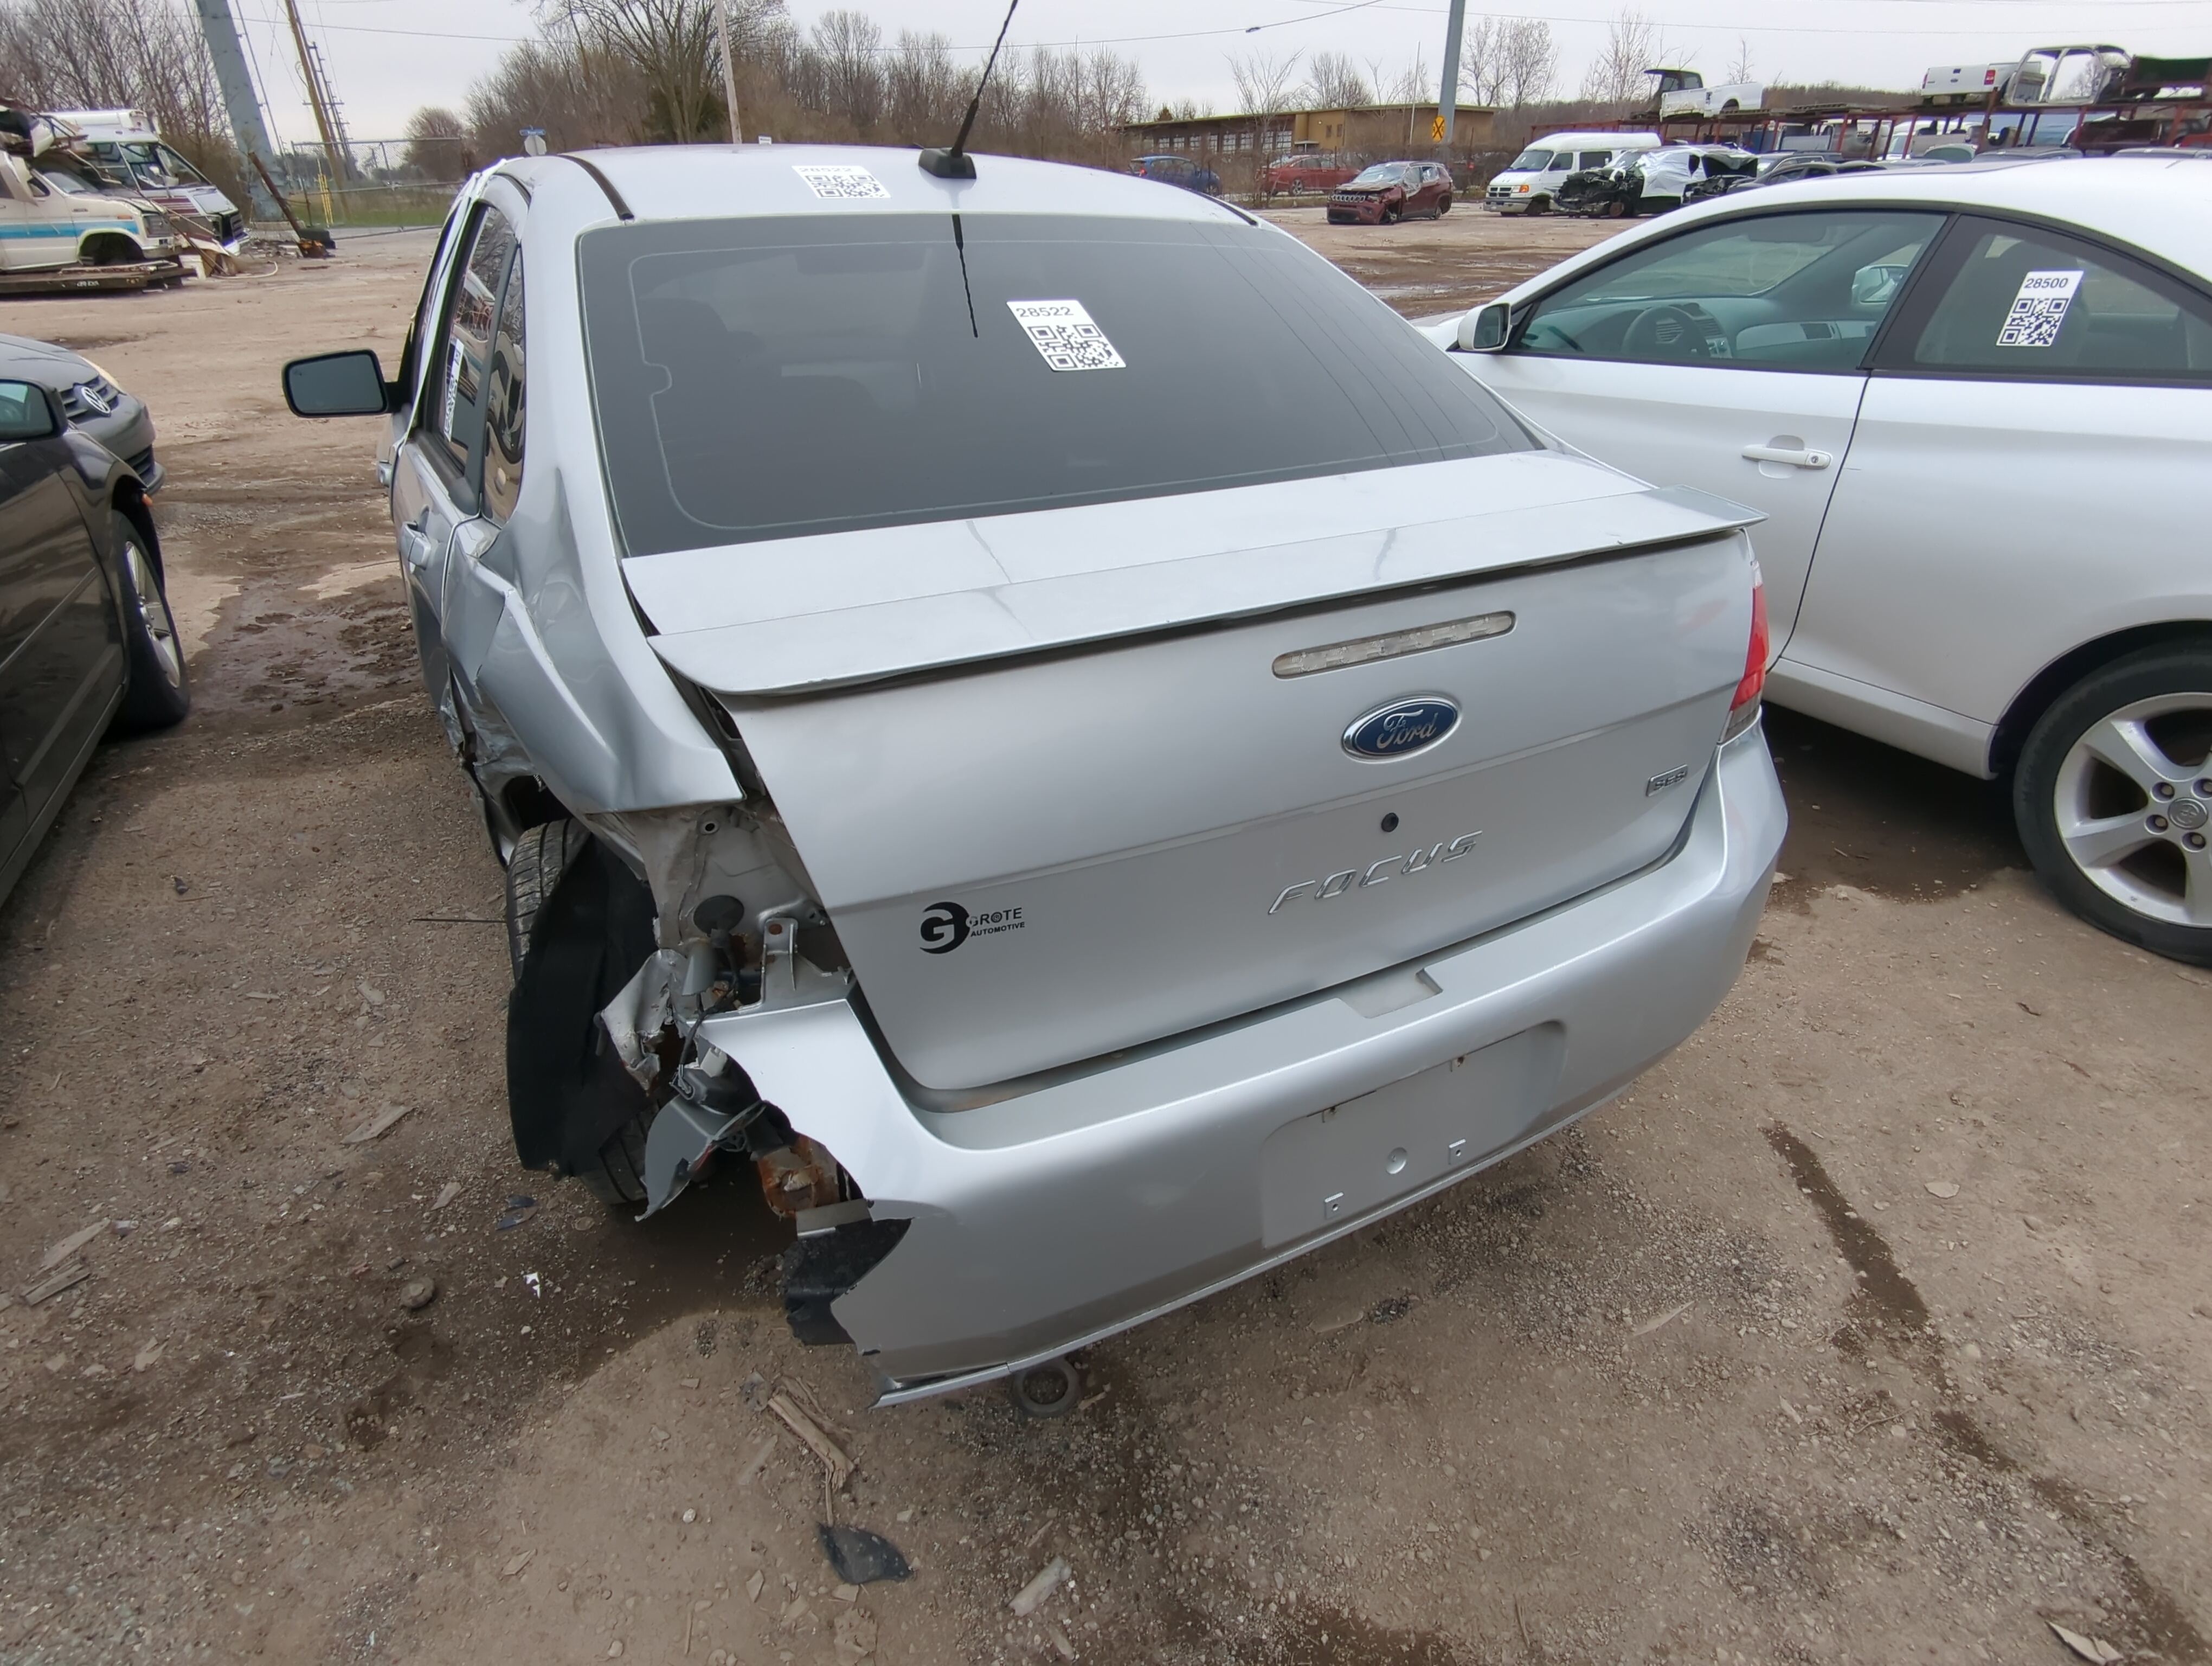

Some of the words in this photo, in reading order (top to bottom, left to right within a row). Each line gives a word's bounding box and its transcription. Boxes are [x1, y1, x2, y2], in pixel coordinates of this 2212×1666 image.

[2023, 278, 2069, 289] 28500
[1015, 306, 1075, 318] 28522
[1376, 708, 1439, 749] Ford
[1653, 771, 1687, 791] SES
[1268, 829, 1483, 915] FOCUS
[969, 907, 1023, 928] GROTE
[970, 921, 1026, 938] AUTOMOTIVE
